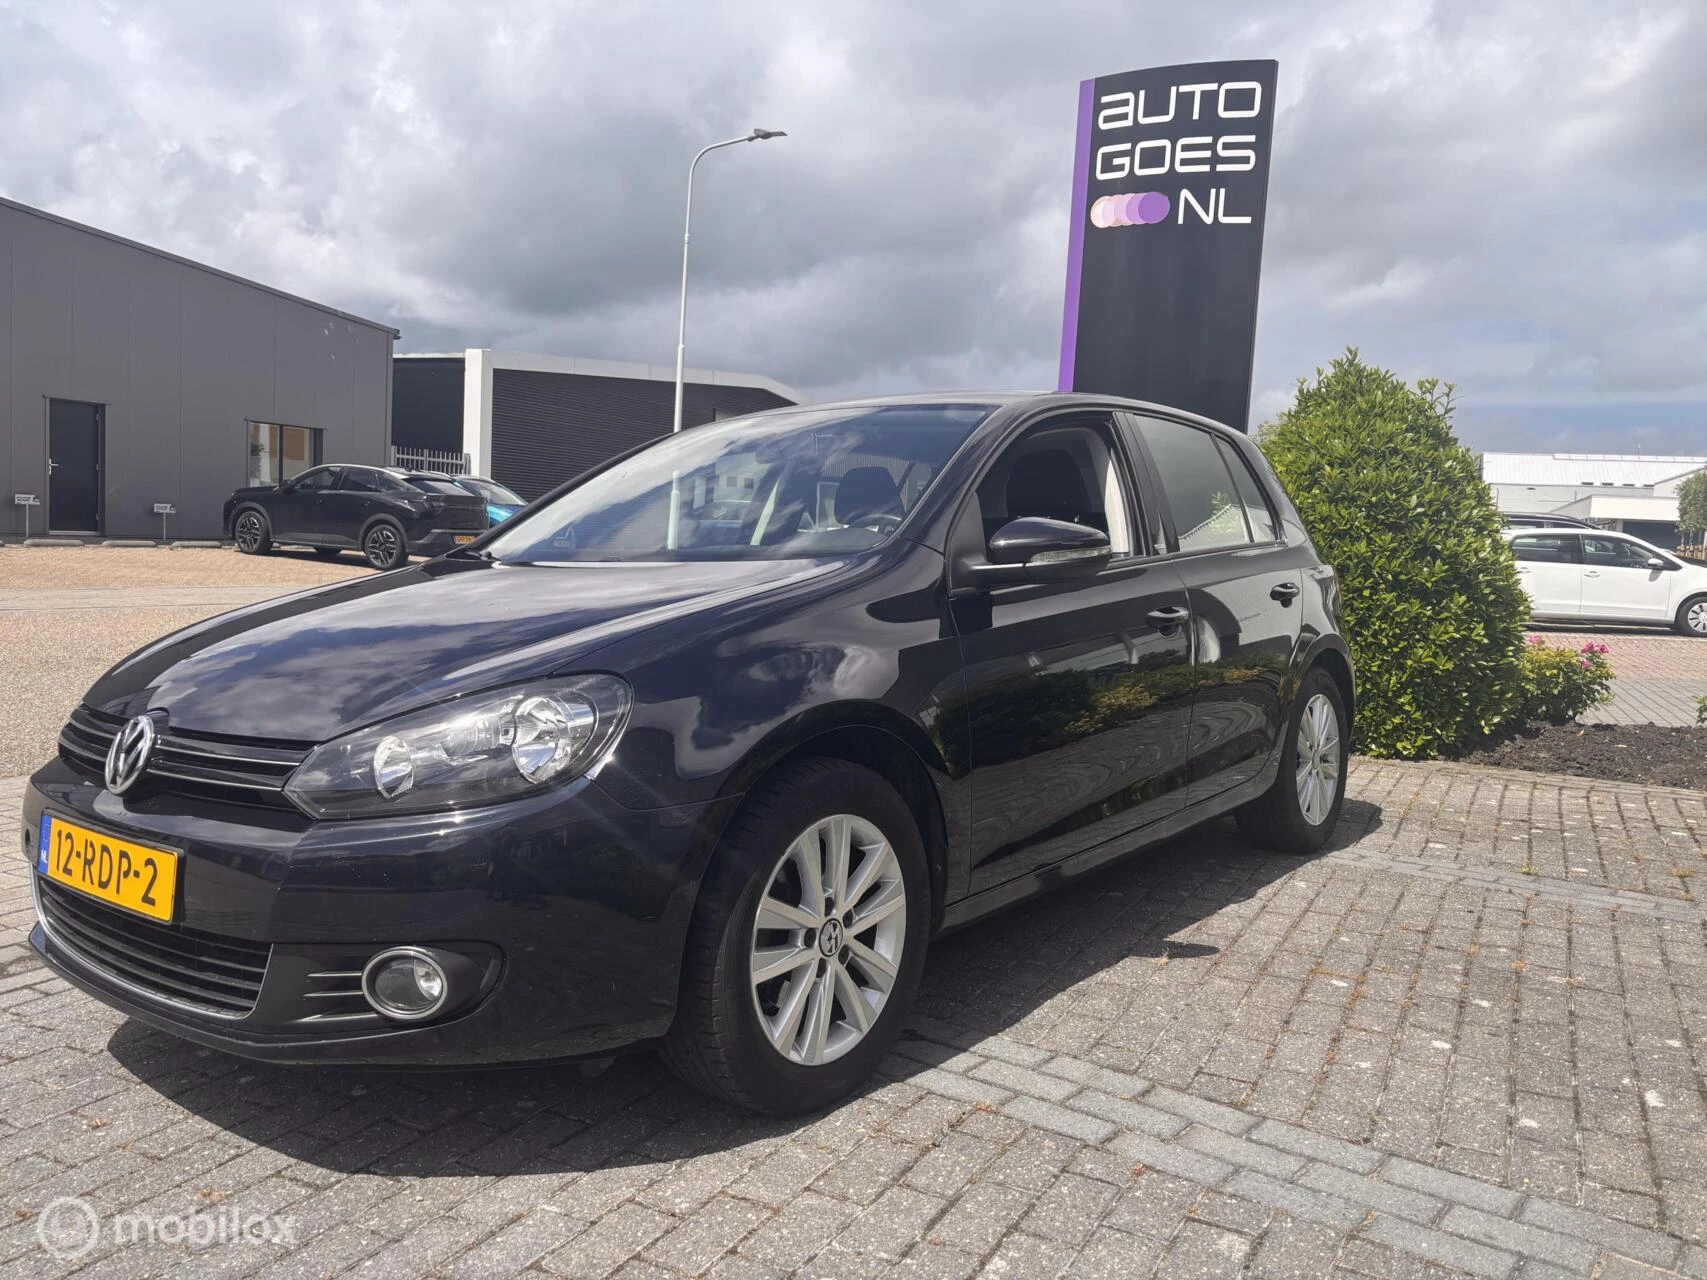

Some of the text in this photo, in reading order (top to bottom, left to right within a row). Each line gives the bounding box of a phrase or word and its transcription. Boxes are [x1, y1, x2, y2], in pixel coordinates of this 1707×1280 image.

[1095, 135, 1256, 180] GOES
[1177, 188, 1252, 225] NL
[56, 829, 157, 907] 12-RDP-2
